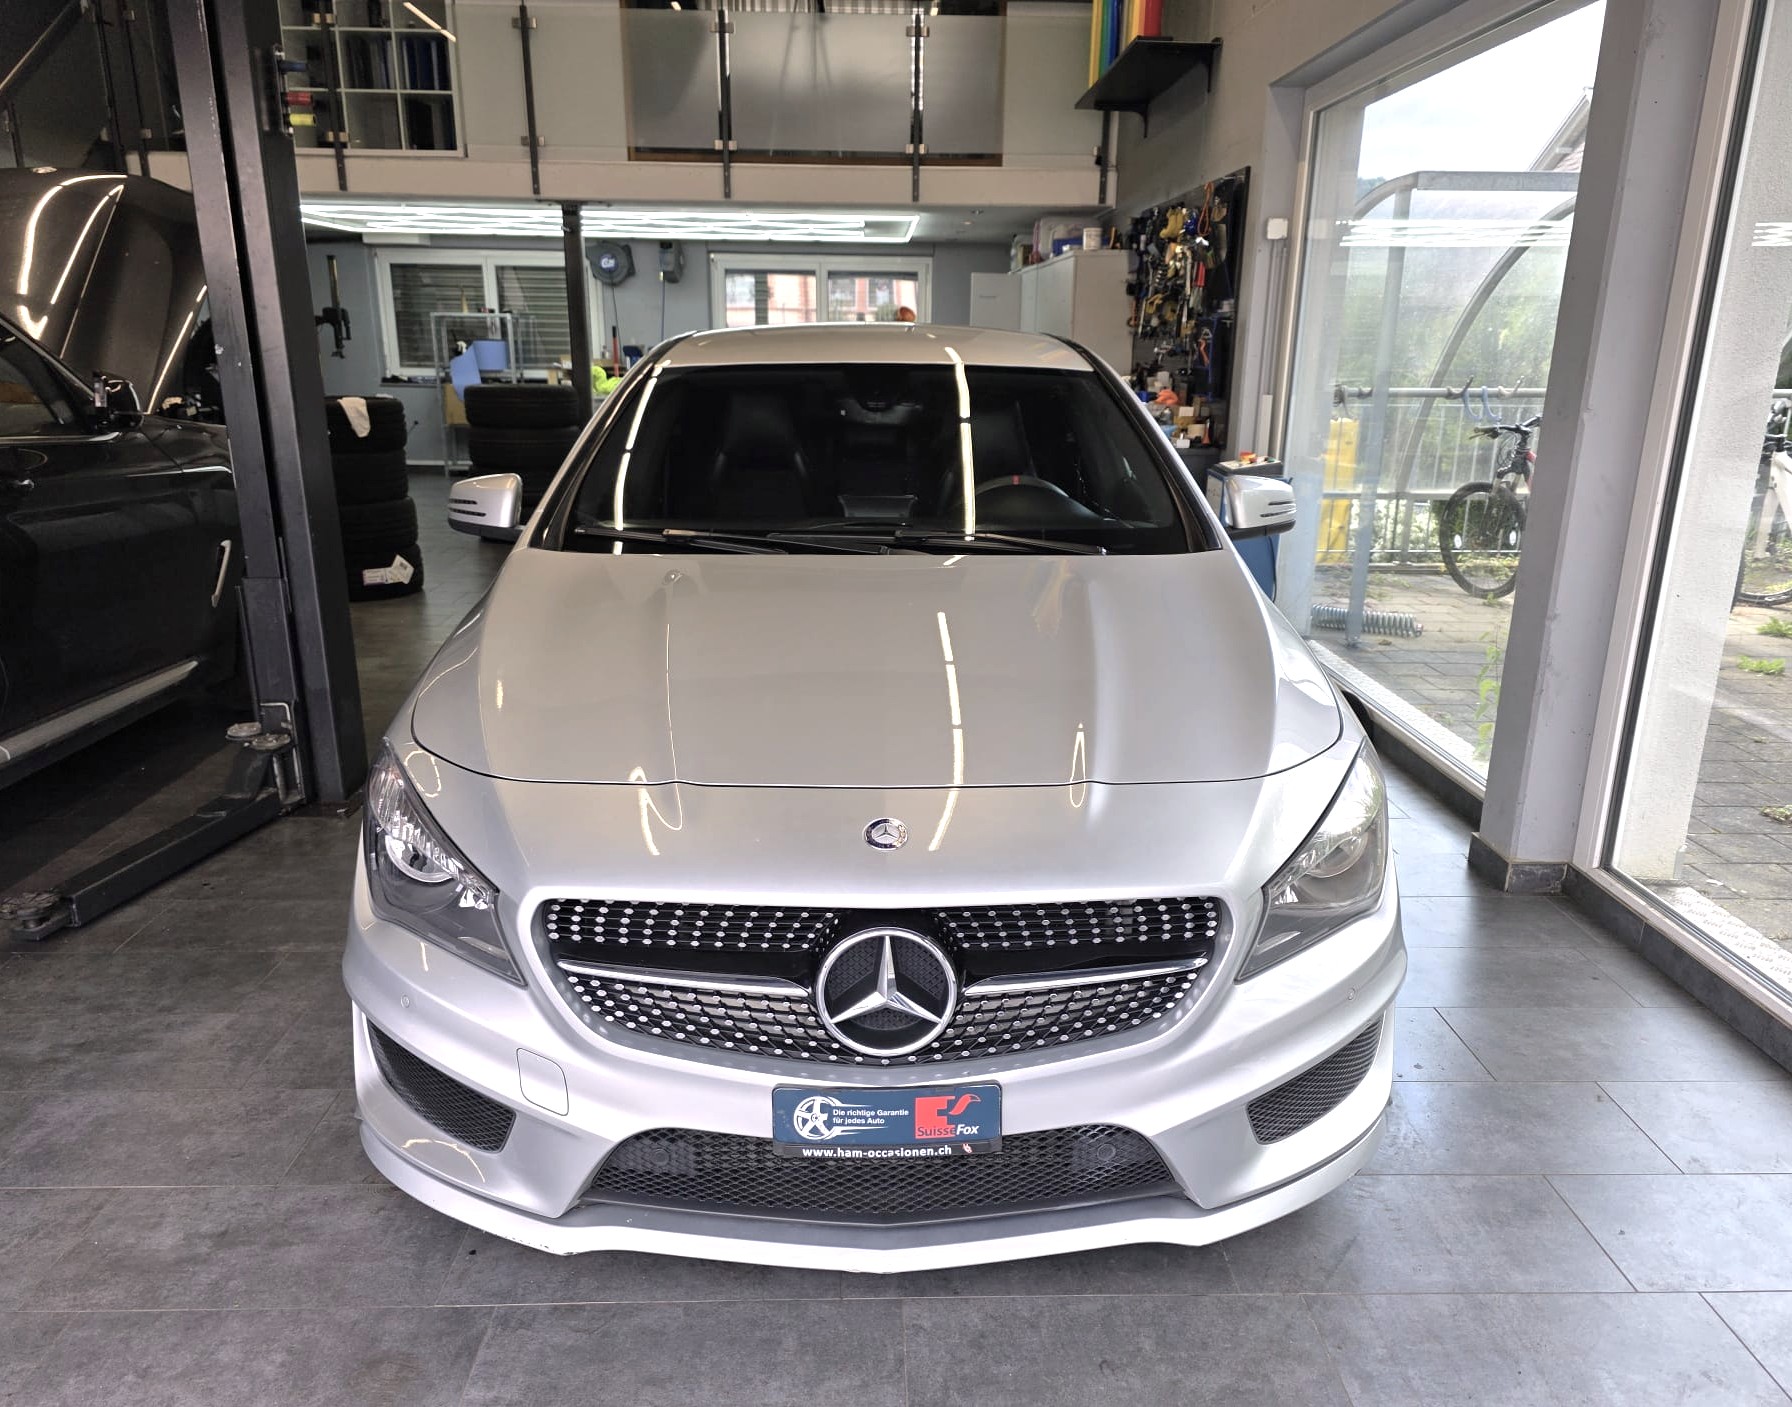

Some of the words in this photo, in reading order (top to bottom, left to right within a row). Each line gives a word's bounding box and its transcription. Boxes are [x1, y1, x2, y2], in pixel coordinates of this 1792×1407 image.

[847, 1109, 875, 1117] richtige
[845, 1117, 865, 1125] jedes
[917, 1124, 979, 1137] SuisseFox
[802, 1145, 952, 1158] www.ham-occasionen.ch
